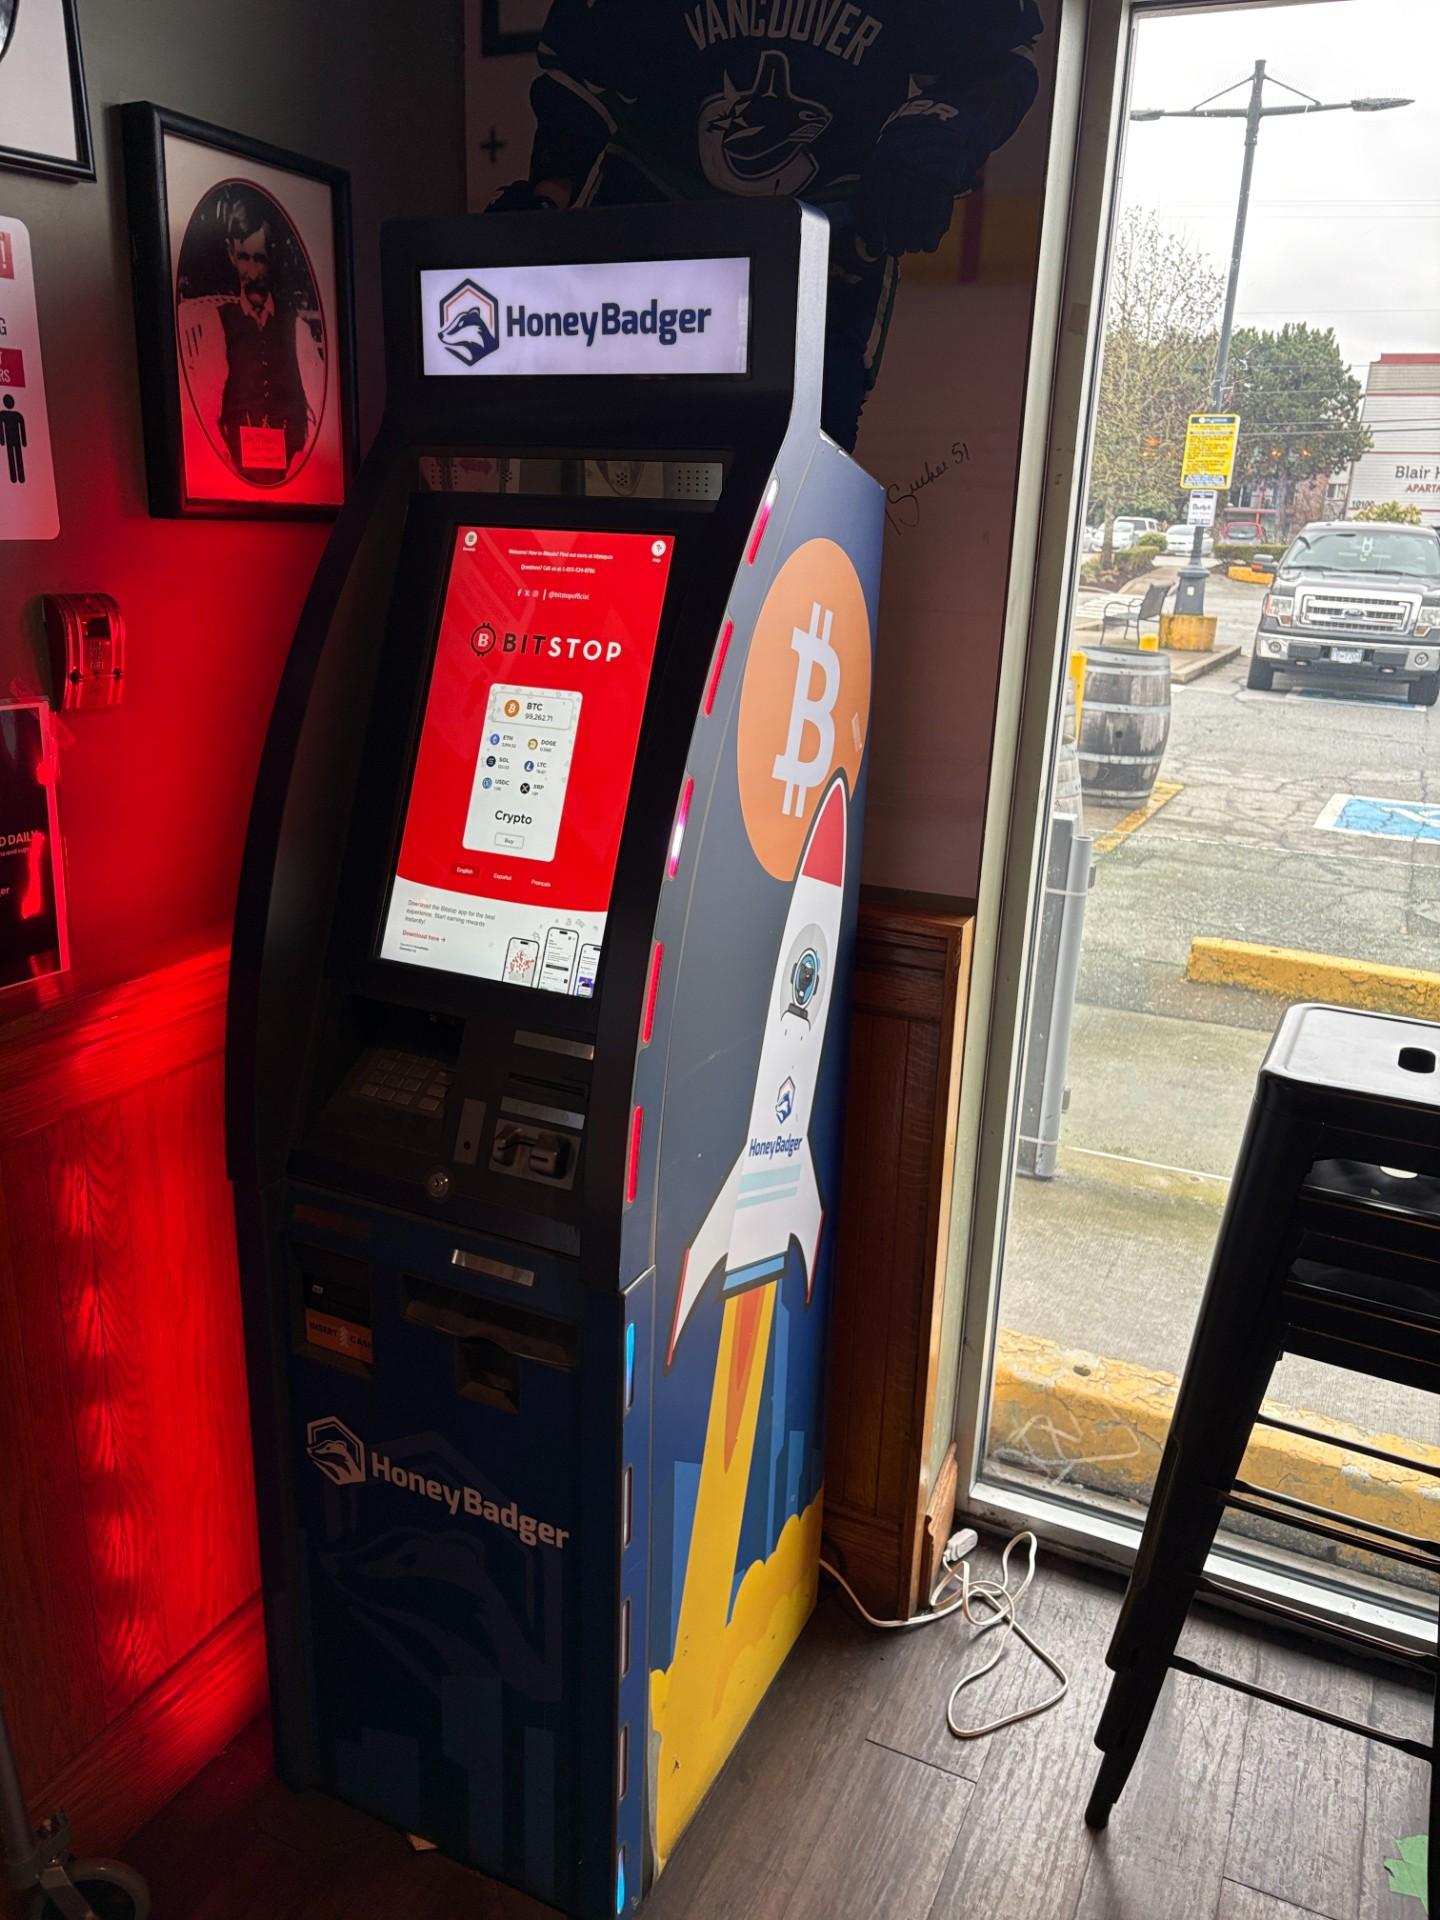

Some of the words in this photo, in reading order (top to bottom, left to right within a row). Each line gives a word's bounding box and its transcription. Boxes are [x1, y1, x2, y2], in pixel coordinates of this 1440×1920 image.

[684, 0, 883, 65] VANCOUVER
[507, 299, 711, 346] HoneyBadger
[1395, 465, 1431, 480] Blair
[503, 632, 621, 662] BITSTOP
[526, 702, 543, 711] BTC
[541, 739, 556, 747] DOGE
[495, 810, 533, 825] Crypto
[402, 929, 427, 939] Download
[749, 1133, 802, 1160] HoneyBadger
[371, 1452, 570, 1549] HoneyBadger
